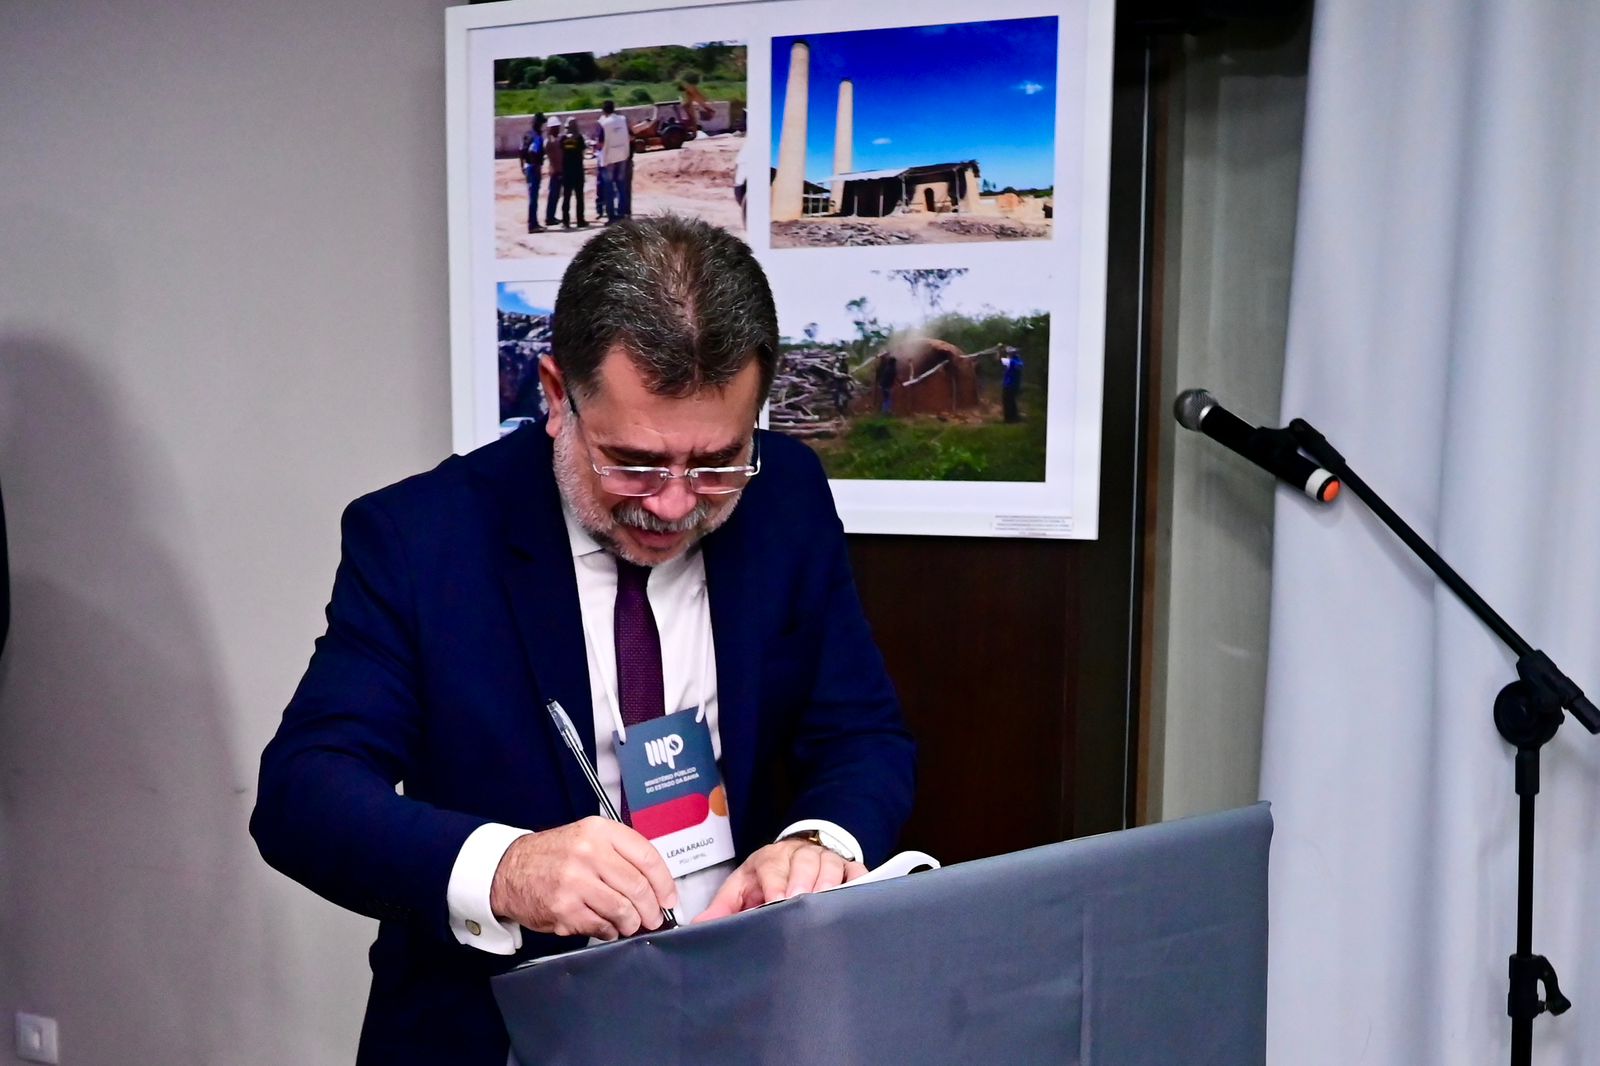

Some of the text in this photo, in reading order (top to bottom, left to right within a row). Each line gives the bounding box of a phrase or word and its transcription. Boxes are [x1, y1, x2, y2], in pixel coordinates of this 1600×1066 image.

[644, 766, 697, 787] MINISTÉRIO PÚBLICO
[645, 772, 700, 794] DO ESTADO DA BAHIA
[666, 847, 685, 859] LEAN
